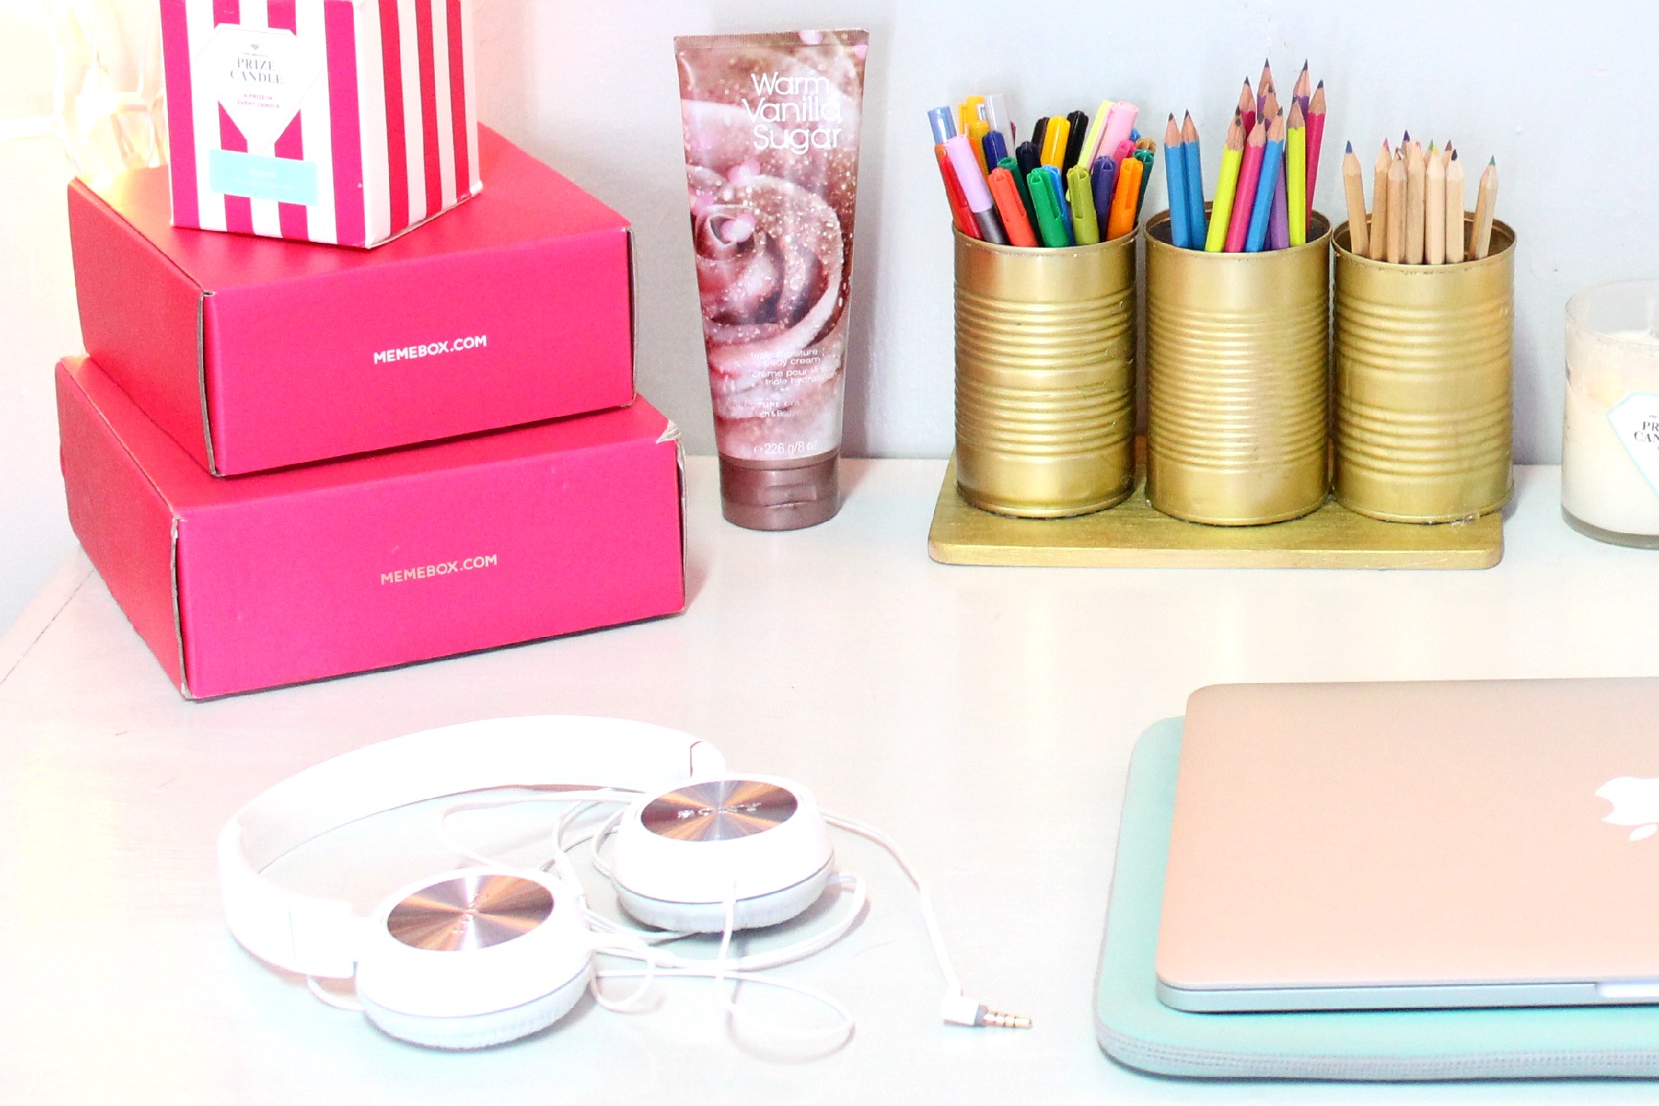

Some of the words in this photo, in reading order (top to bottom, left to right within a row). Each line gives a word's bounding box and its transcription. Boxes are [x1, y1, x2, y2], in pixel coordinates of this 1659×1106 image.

[237, 58, 275, 71] PRIZE
[230, 70, 284, 85] CANDLE
[751, 71, 830, 96] Warm
[742, 97, 842, 123] Vanilla
[753, 124, 842, 155] Sugar
[374, 335, 488, 365] MEMEBOX.COM
[764, 443, 785, 454] 226
[380, 554, 498, 585] MEMEBOX.COM
